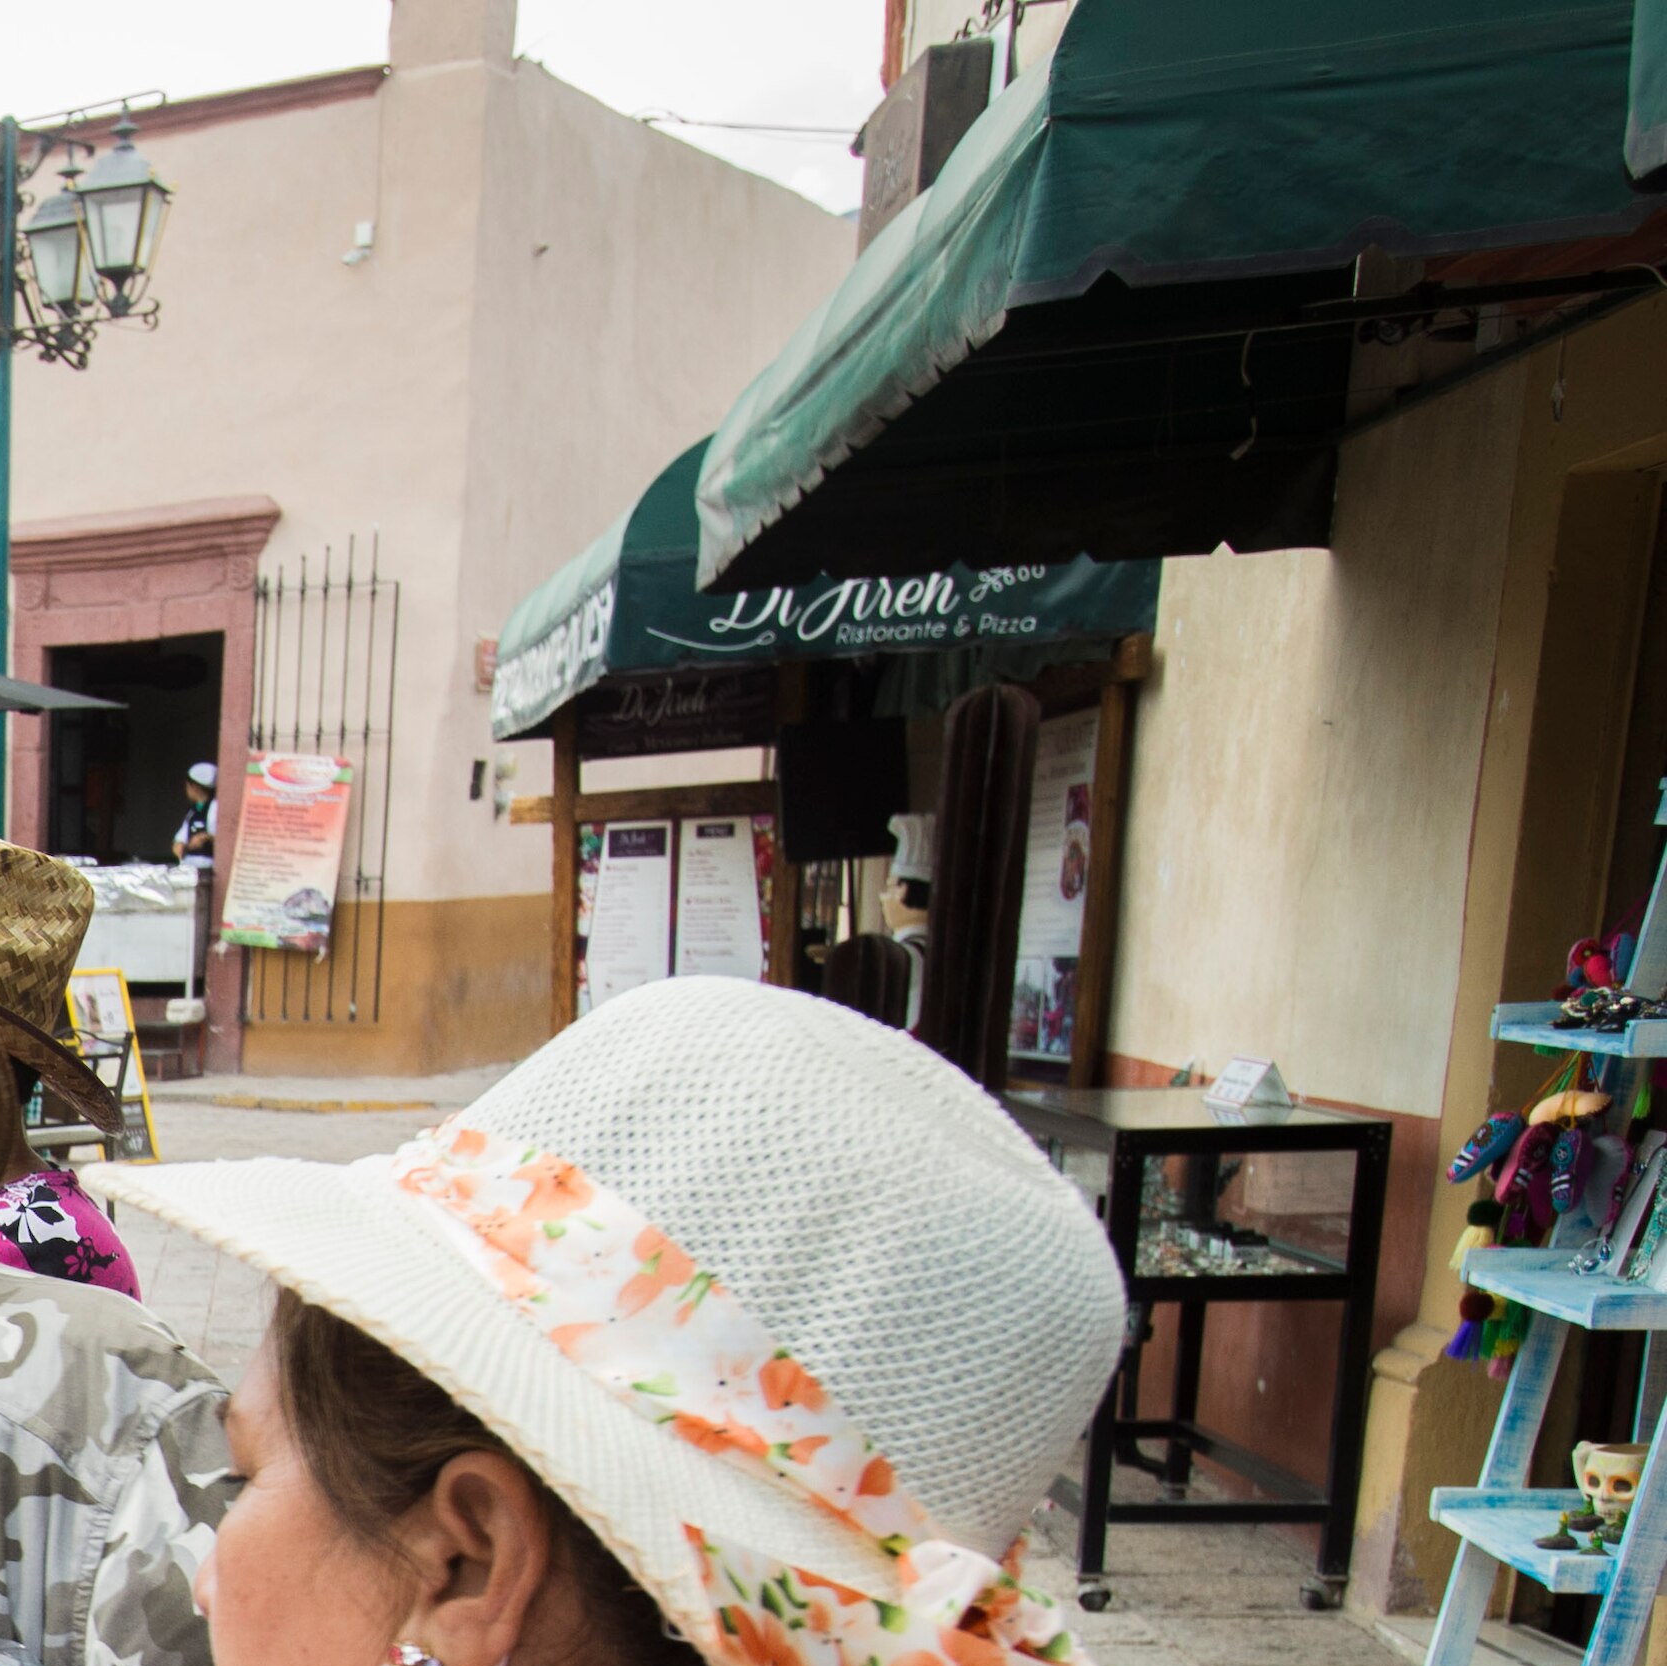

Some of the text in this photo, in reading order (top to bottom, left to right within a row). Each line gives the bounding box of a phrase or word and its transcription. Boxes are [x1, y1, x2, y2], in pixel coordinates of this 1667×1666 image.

[836, 612, 1038, 646] Ristorante & Pizza
